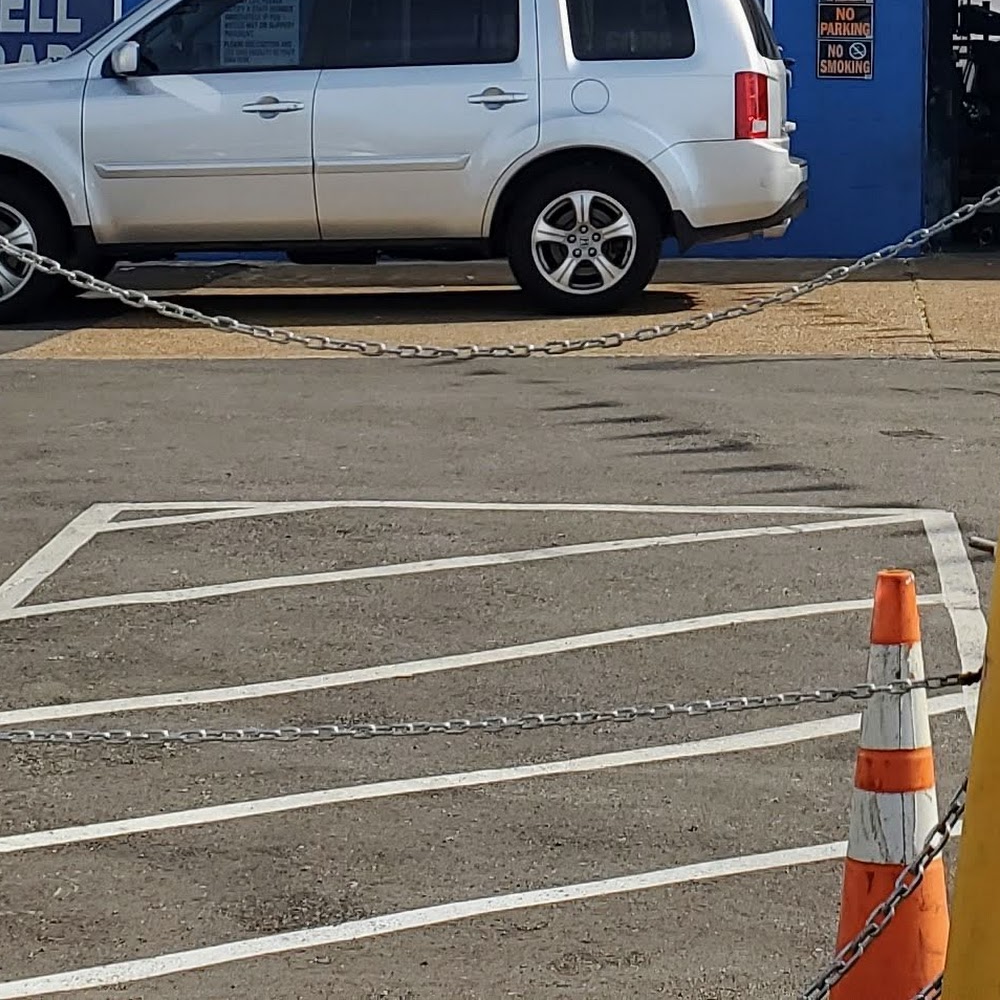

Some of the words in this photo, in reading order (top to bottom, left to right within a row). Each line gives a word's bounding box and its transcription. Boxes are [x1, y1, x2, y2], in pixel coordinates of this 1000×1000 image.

[835, 7, 855, 21] NO
[820, 22, 871, 36] PARKING
[827, 44, 844, 58] NO
[820, 59, 871, 74] SMOKING
